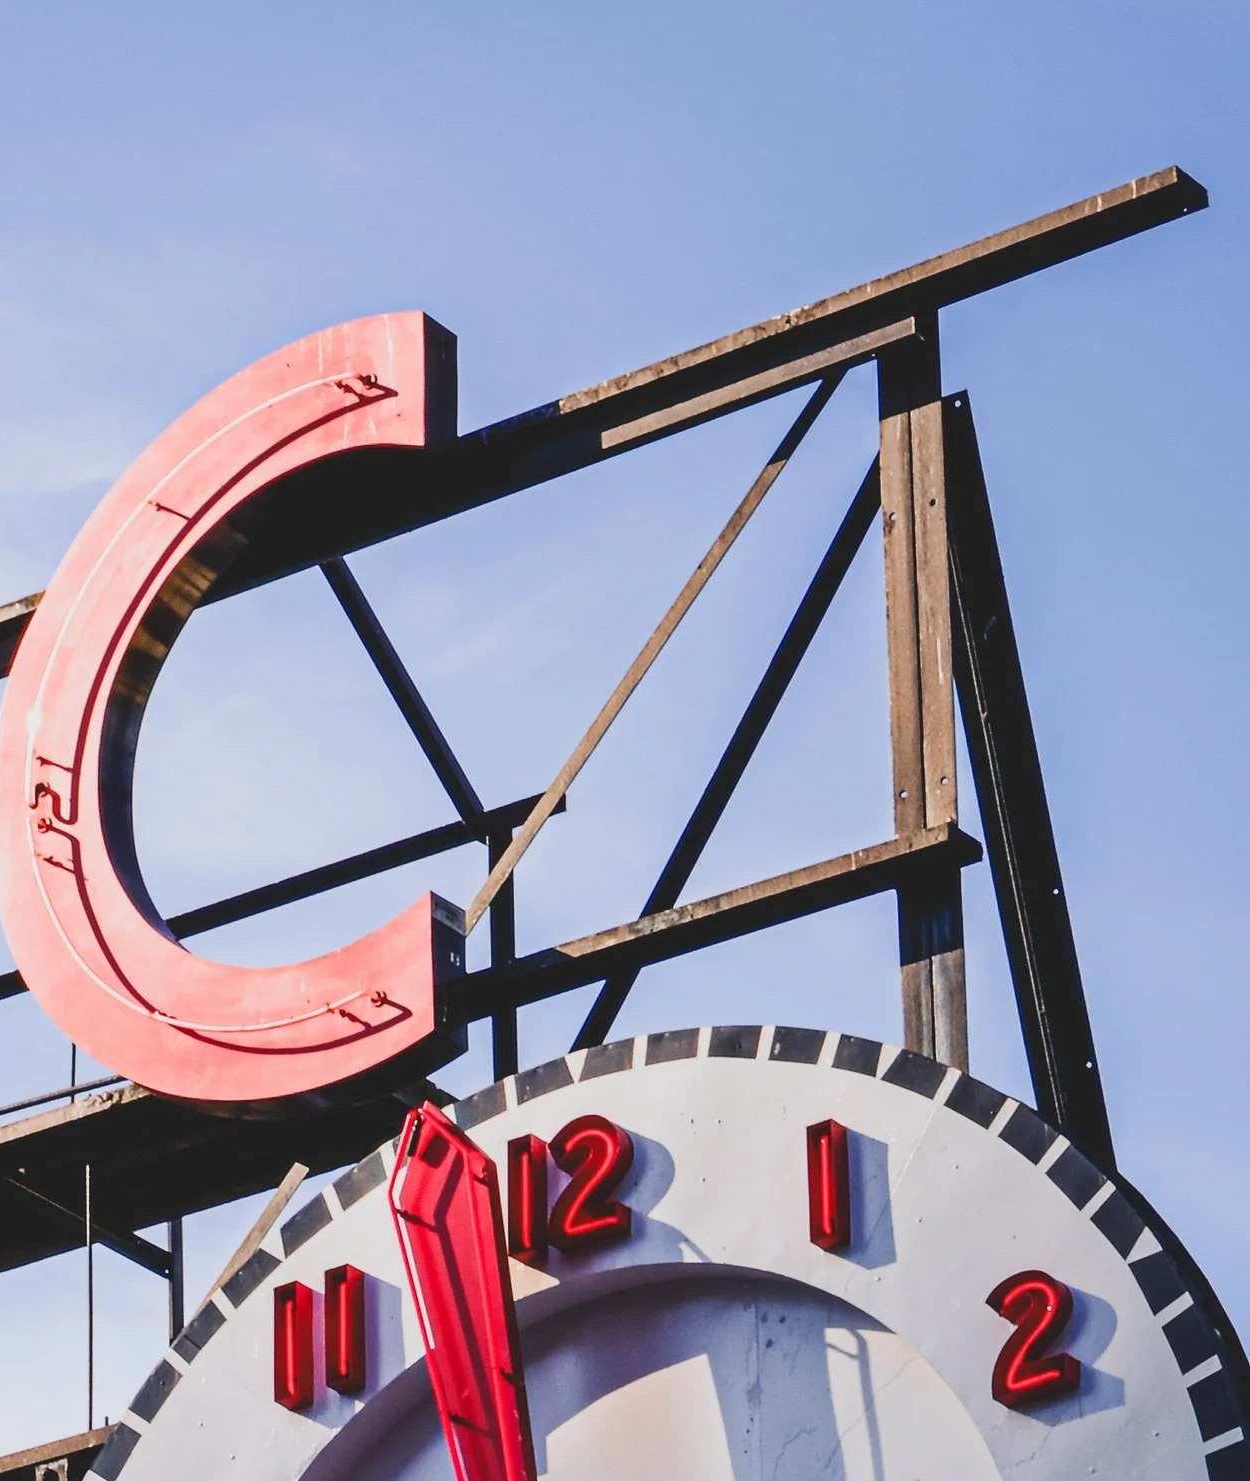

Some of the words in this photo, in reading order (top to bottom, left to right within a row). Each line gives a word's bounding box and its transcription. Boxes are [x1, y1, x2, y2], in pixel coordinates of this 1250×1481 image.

[508, 1114, 634, 1267] 12
[806, 1118, 853, 1252] 1
[273, 1262, 367, 1412] 11
[988, 1271, 1082, 1409] 2
